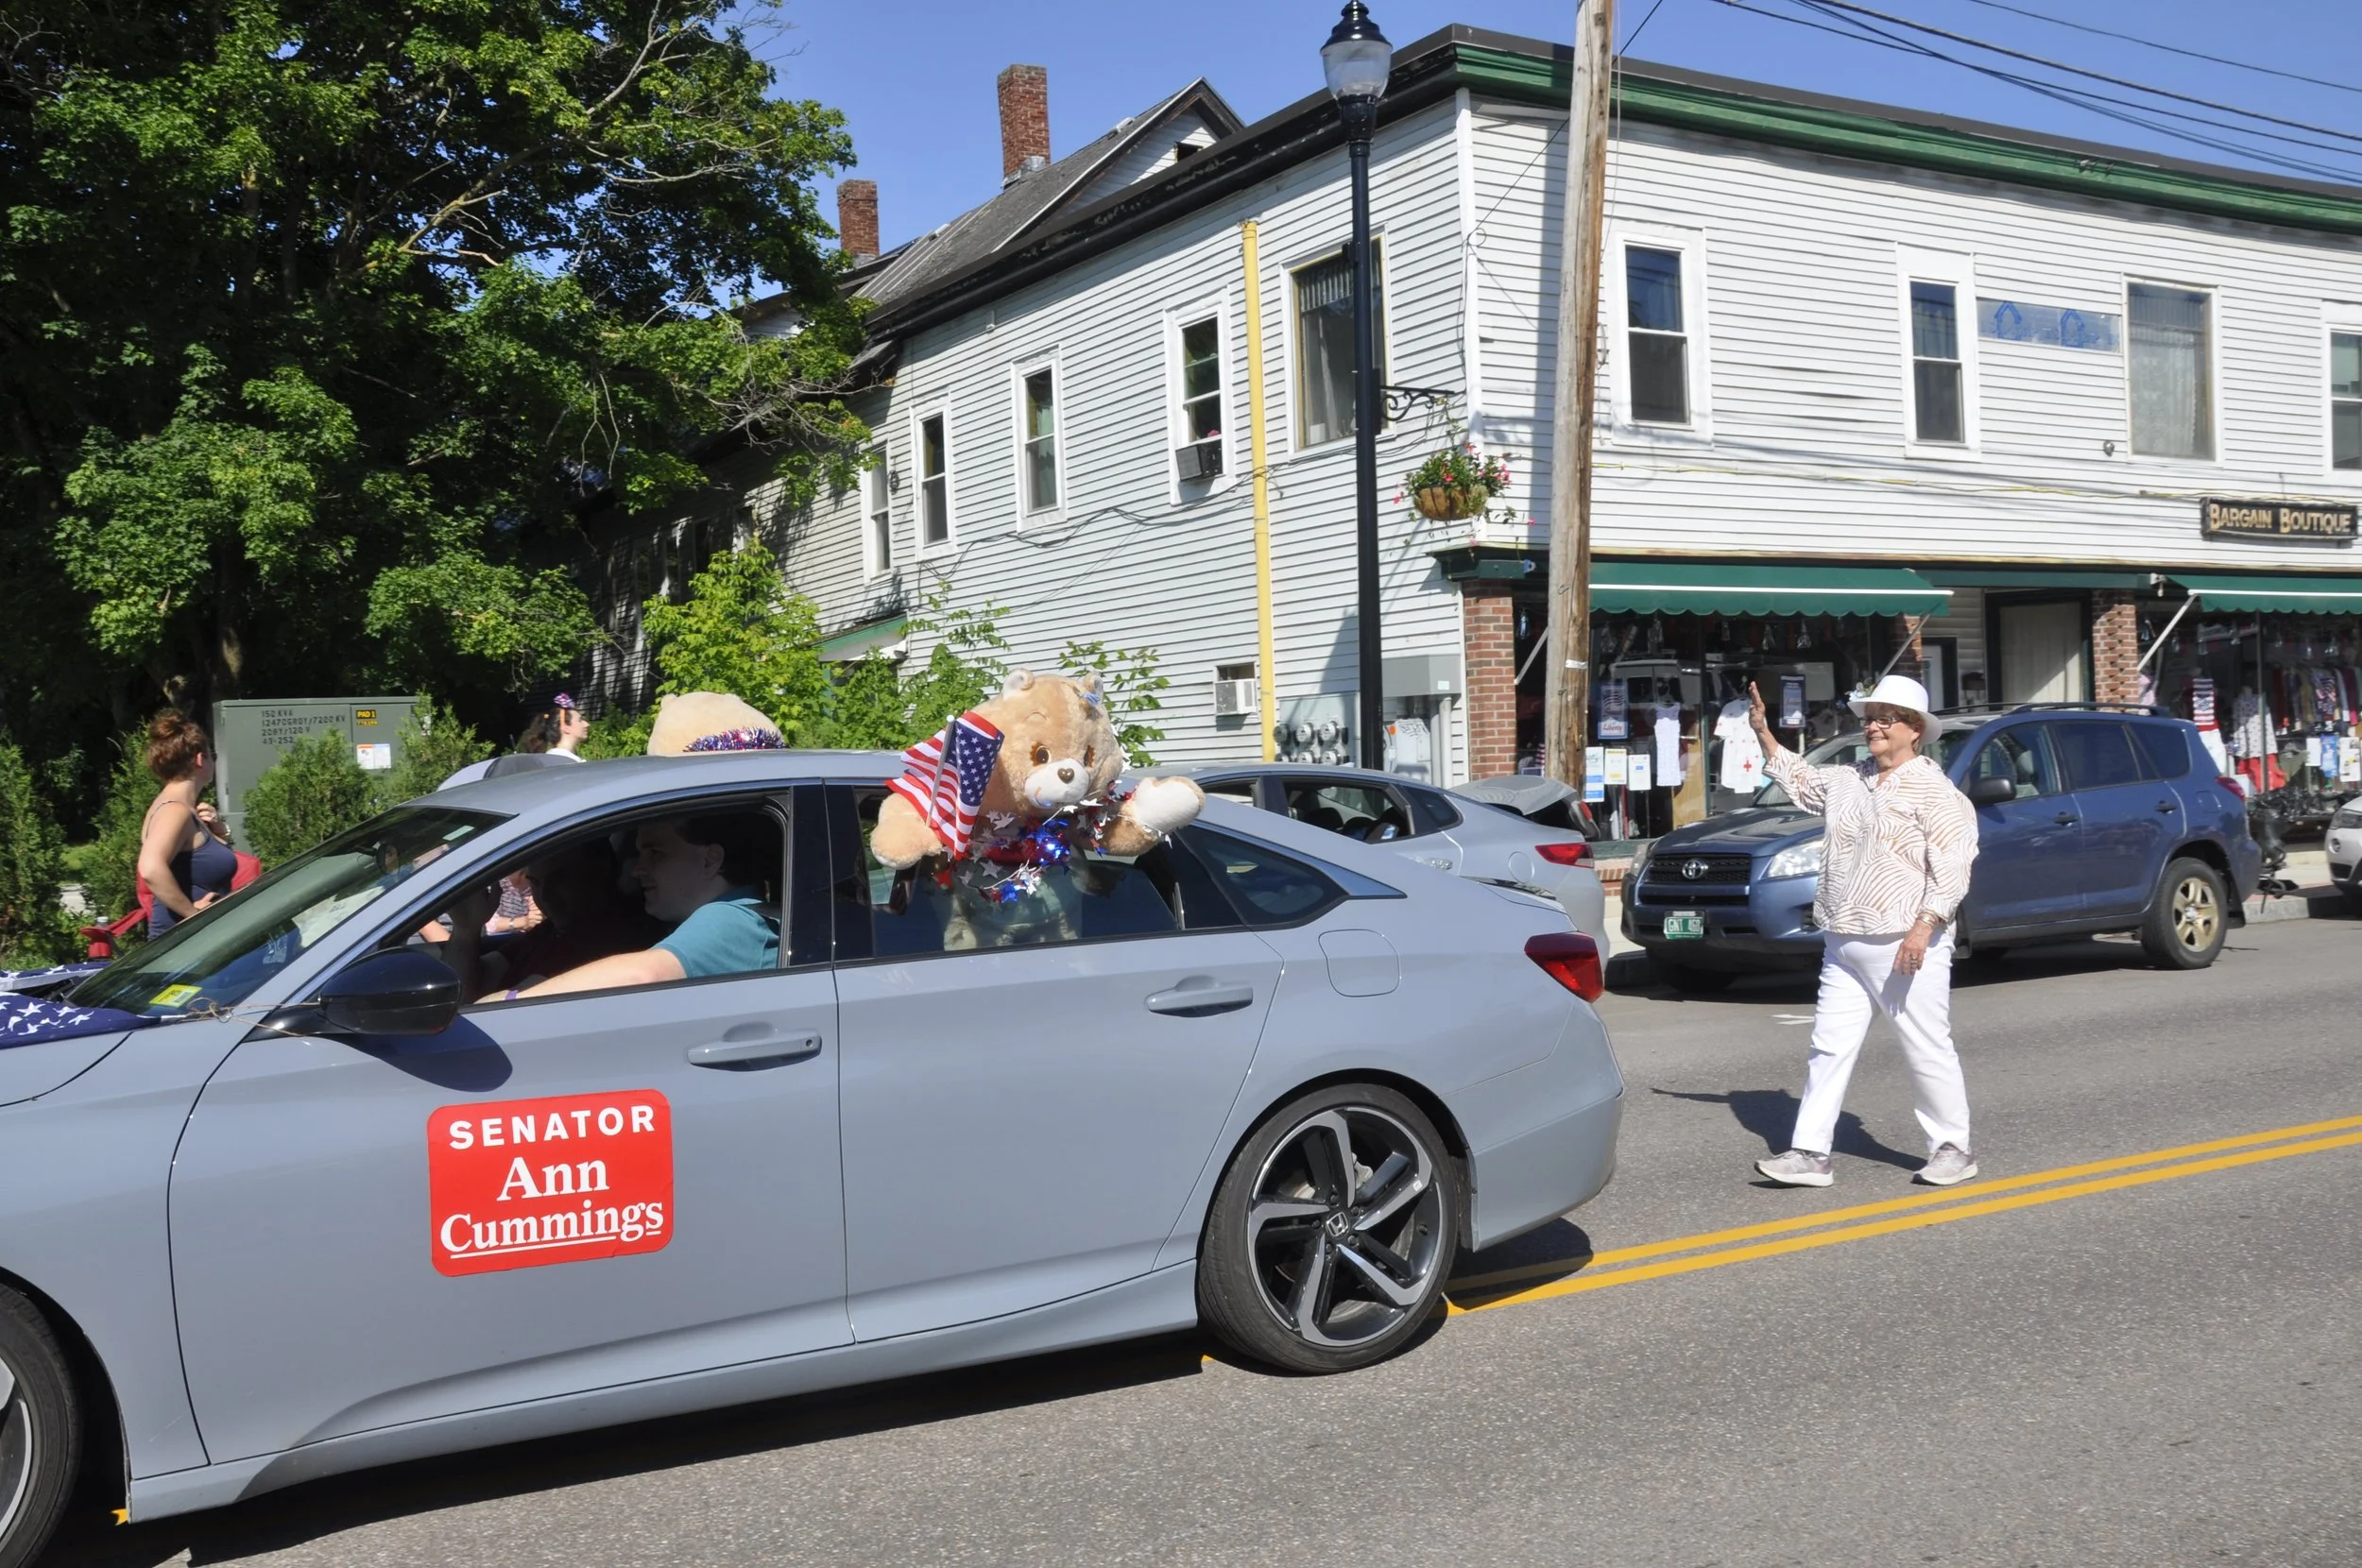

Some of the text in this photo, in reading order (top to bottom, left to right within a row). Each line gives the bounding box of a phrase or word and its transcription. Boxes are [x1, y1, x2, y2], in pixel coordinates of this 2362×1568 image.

[2209, 503, 2352, 534] BARGAIN BOUTIQUE
[262, 709, 276, 718] 150
[449, 1105, 656, 1150] SENATOR
[496, 1156, 610, 1202] Ann
[439, 1199, 664, 1253] Cummings
